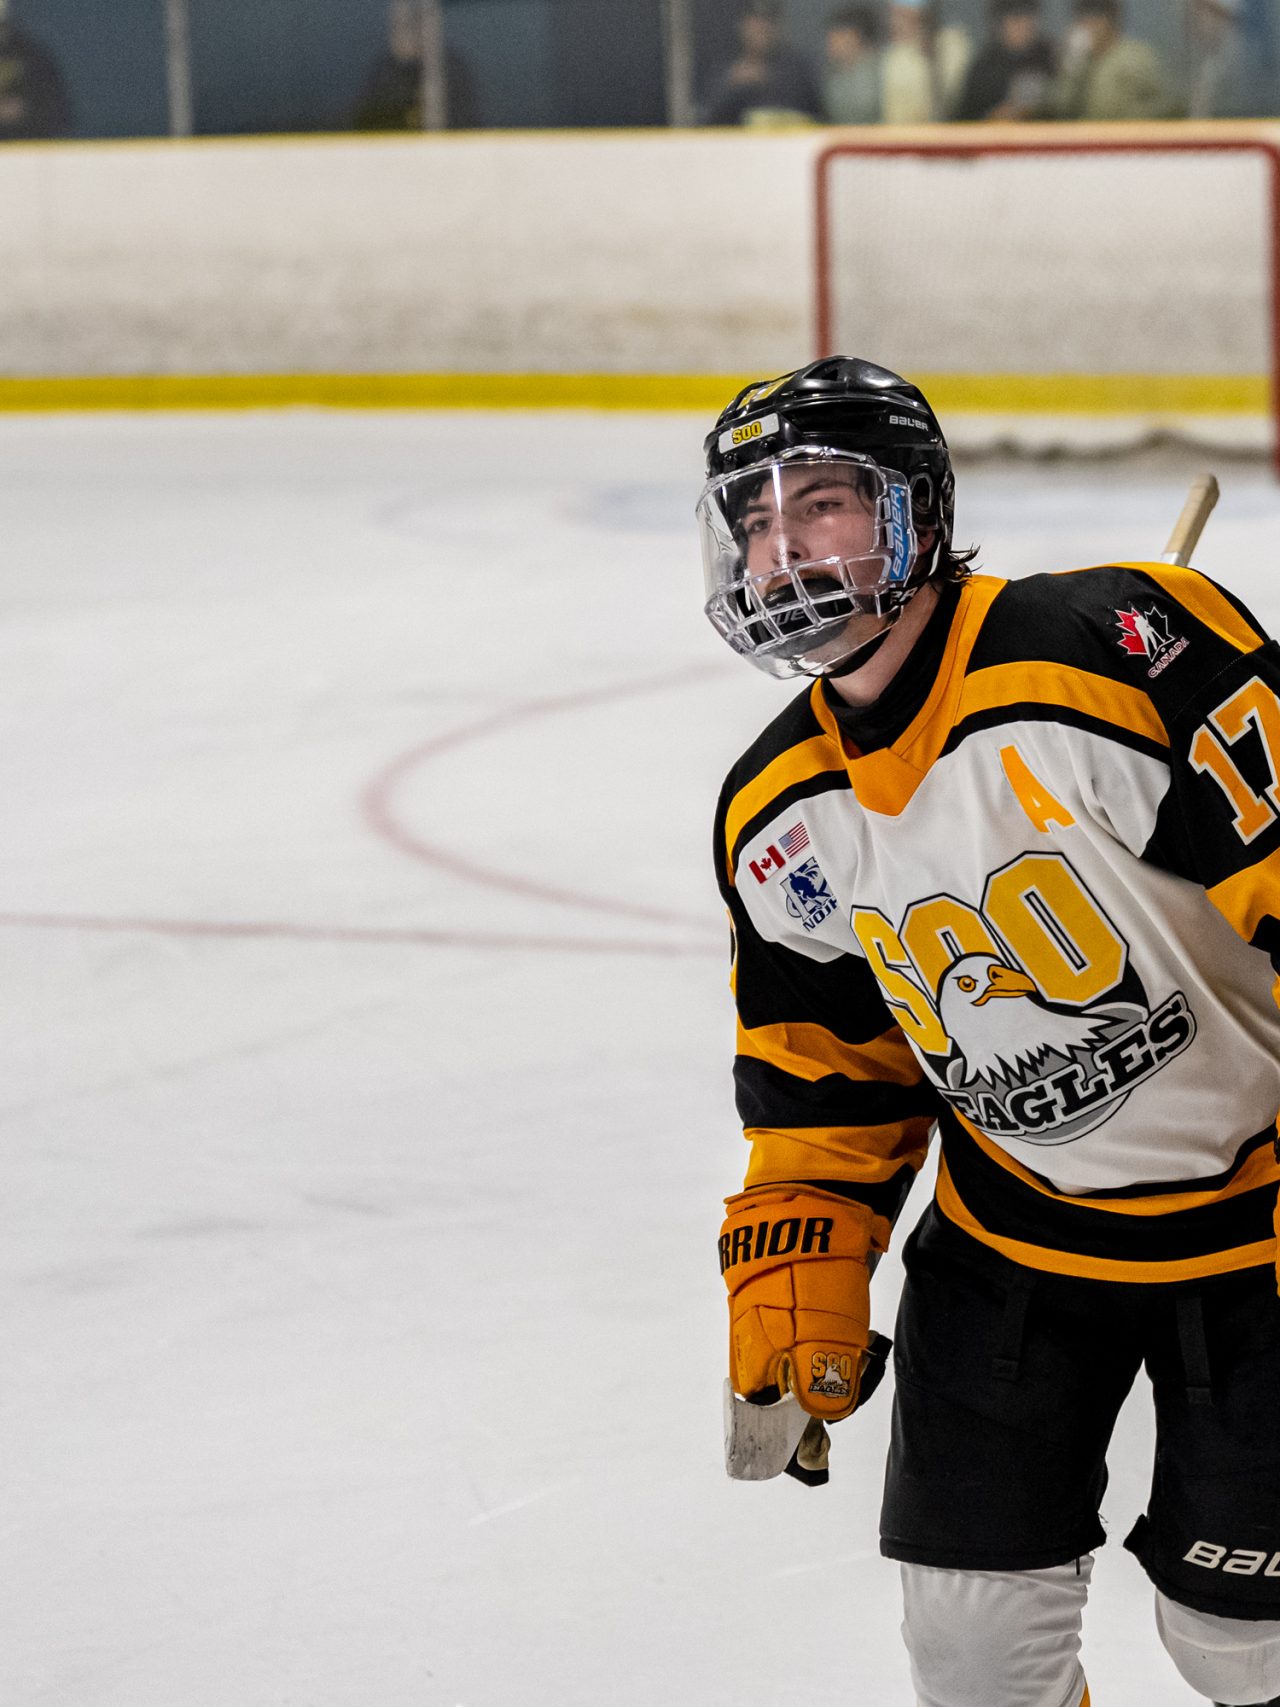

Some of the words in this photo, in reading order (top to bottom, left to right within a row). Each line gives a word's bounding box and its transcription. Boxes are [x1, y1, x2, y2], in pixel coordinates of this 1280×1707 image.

[732, 421, 762, 444] SOO
[1148, 636, 1190, 678] CANADA
[999, 744, 1077, 834] A
[945, 992, 1196, 1135] EAGLES
